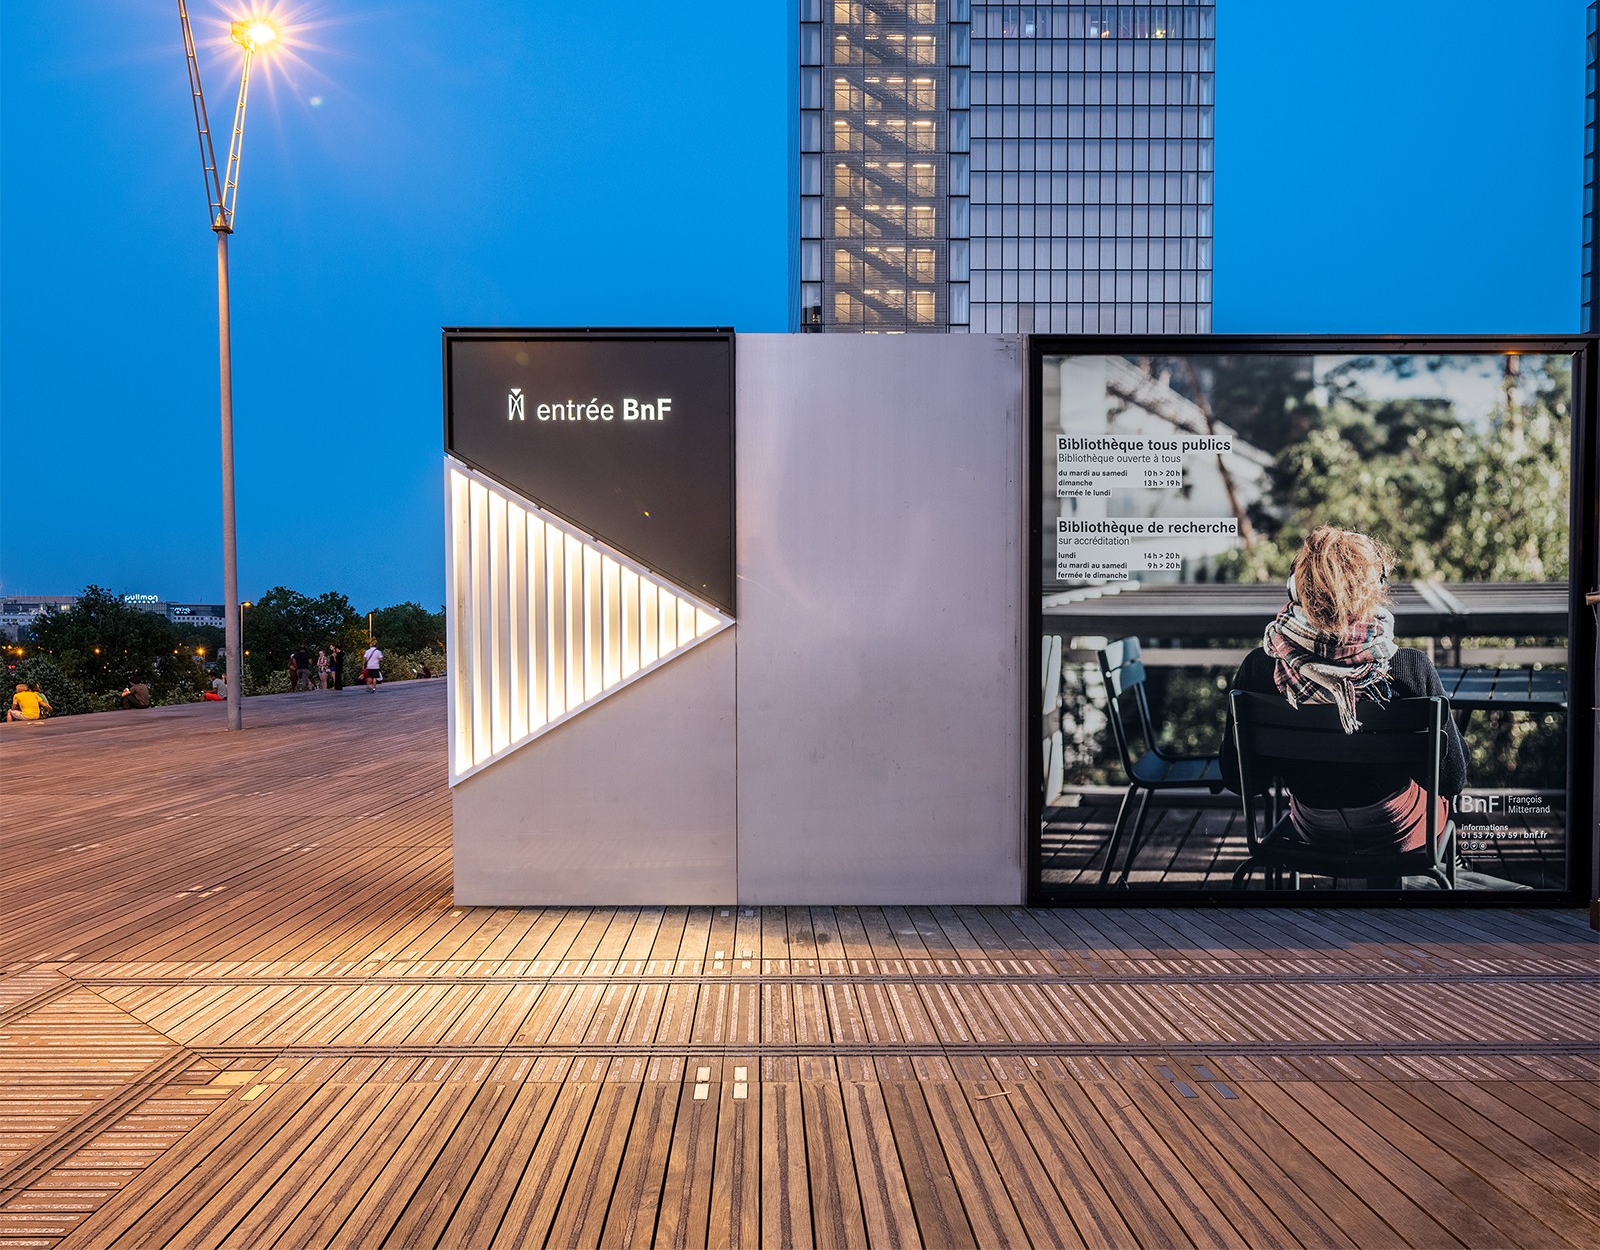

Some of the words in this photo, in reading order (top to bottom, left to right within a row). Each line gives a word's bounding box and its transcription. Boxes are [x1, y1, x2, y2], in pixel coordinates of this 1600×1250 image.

[537, 398, 615, 422] entrée
[623, 398, 672, 421] BnF
[1058, 437, 1144, 454] Bibliothèque
[1147, 439, 1178, 451] tous
[1182, 438, 1231, 454] publics
[1058, 453, 1115, 464] Bibliothèque
[1116, 454, 1151, 464] ouverte
[1153, 453, 1160, 463] à
[1161, 454, 1182, 464] tous
[1058, 469, 1068, 477] du
[1069, 469, 1090, 477] mardi
[1101, 469, 1128, 477] samedi
[1058, 479, 1093, 487] dimanche
[1058, 488, 1084, 497] fermée
[1084, 489, 1092, 497] le
[1093, 489, 1111, 497] lundi
[1058, 520, 1144, 535] Bibliothèque
[1148, 521, 1165, 533] de
[1168, 522, 1237, 534] recherche
[1058, 537, 1073, 545] sur
[1074, 536, 1130, 546] accréditation
[1058, 551, 1077, 559] lundi
[1057, 561, 1068, 569] du
[1069, 561, 1090, 569] mardi
[1101, 562, 1128, 570] samedi
[1057, 571, 1084, 579] fermée
[1084, 571, 1092, 579] le
[1092, 571, 1128, 579] dimanche
[1508, 795, 1542, 806] François
[1508, 805, 1551, 814] Mitterrand
[1523, 830, 1548, 839] bnf.fr
